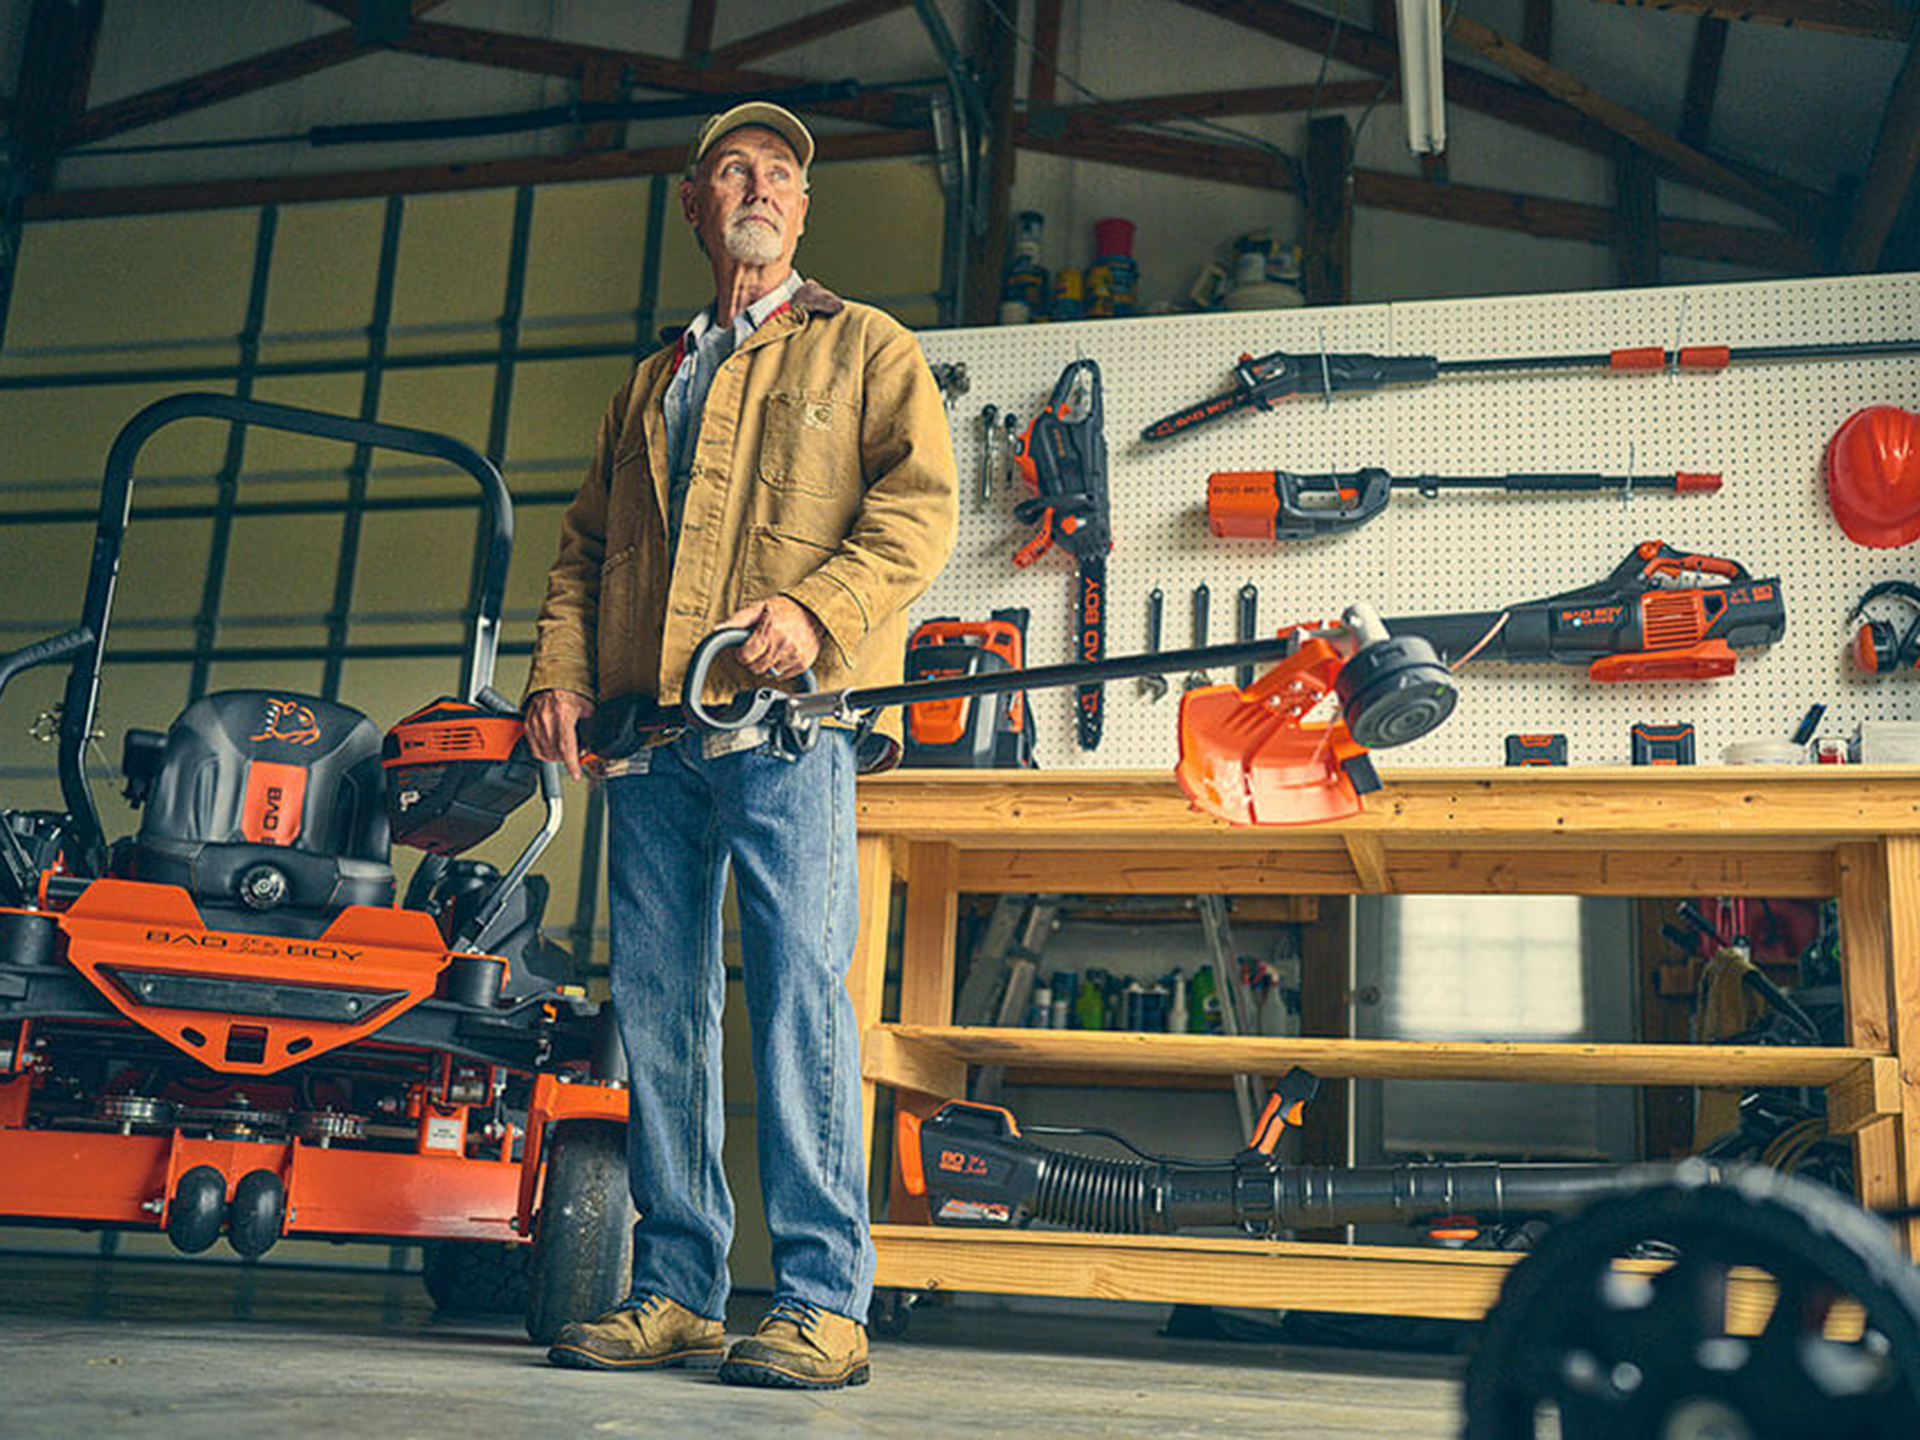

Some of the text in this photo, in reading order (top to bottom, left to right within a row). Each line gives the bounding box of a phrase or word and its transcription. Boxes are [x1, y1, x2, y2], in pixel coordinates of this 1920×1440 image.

[1084, 577, 1101, 664] AD BOY
[263, 787, 283, 831] BAD
[146, 929, 364, 961] BAD BOY
